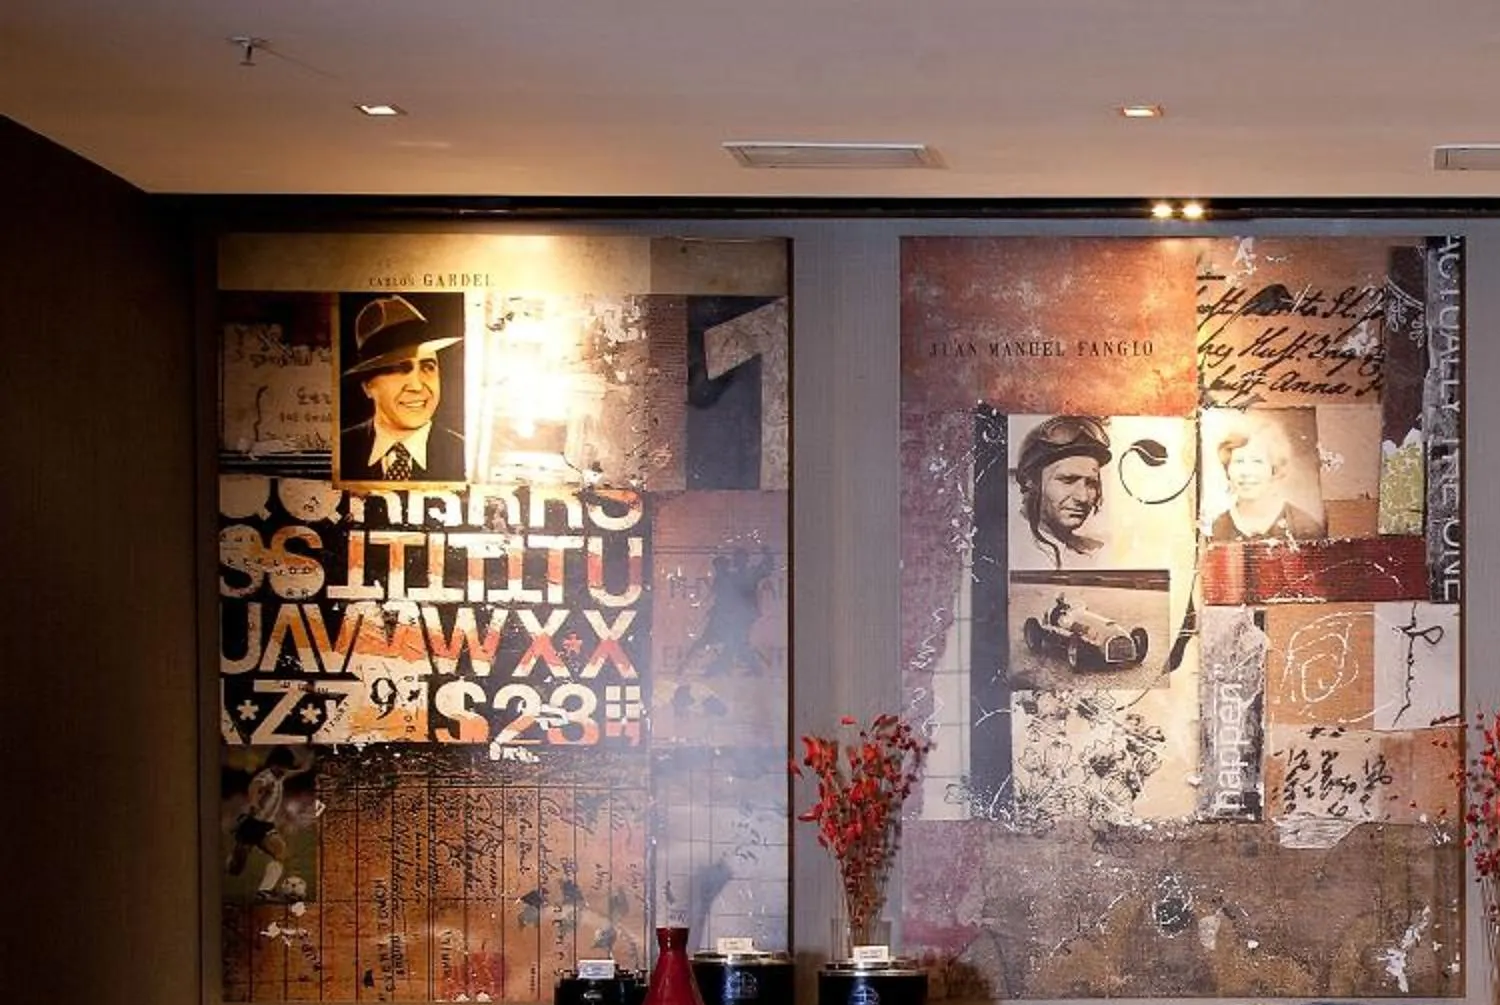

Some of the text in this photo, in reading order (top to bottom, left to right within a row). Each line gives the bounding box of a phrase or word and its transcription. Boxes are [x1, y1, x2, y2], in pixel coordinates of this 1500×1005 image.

[929, 341, 1154, 357] JUAN MANUEL FANGIO
